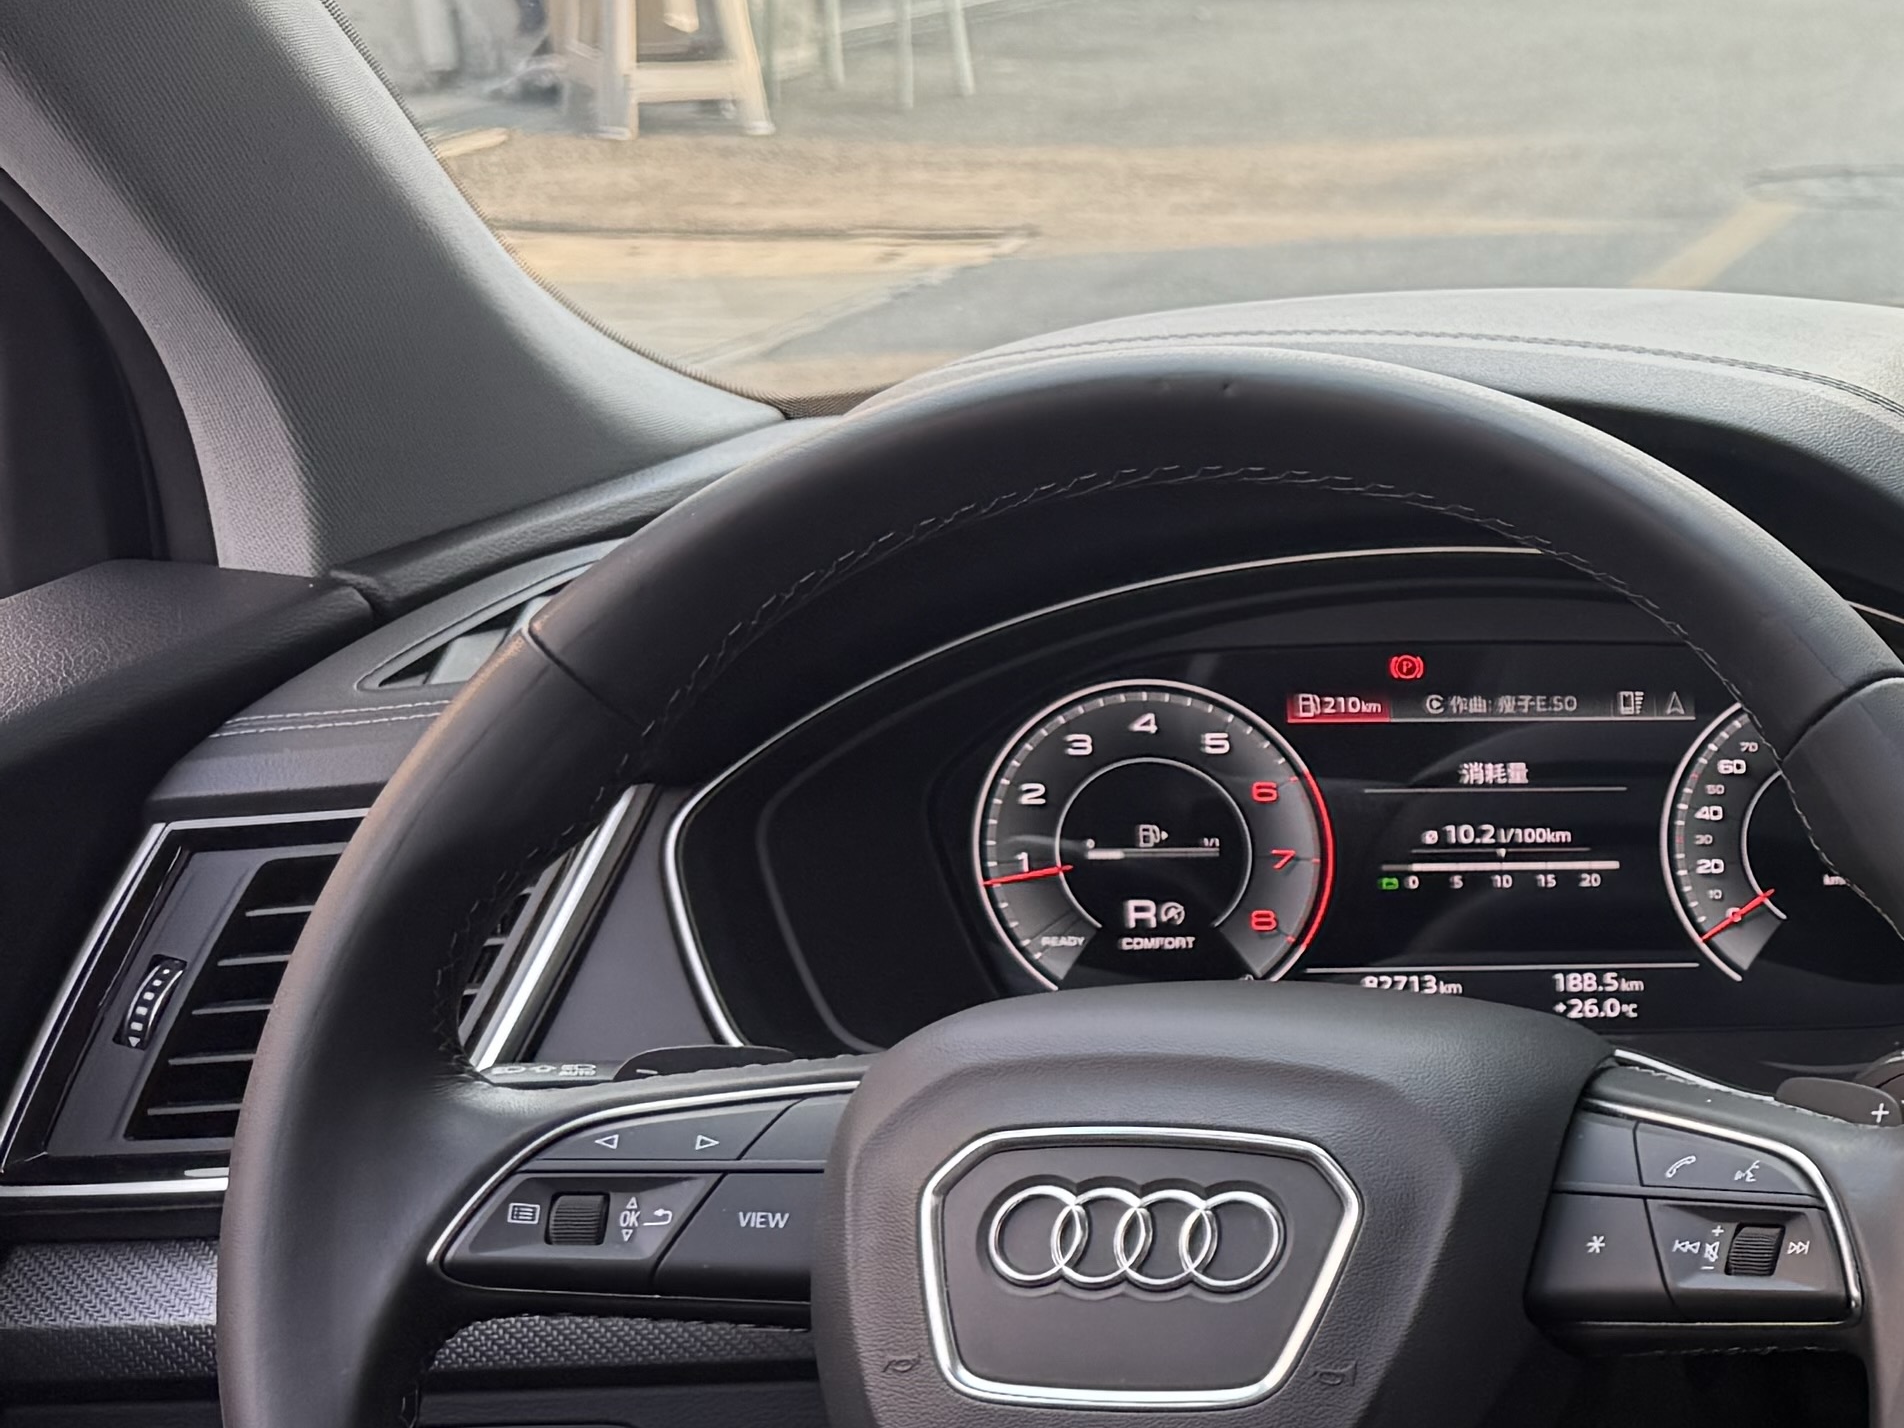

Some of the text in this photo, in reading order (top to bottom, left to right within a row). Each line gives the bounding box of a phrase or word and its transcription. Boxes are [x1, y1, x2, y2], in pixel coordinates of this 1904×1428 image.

[1130, 712, 1158, 735] 4
[1065, 733, 1093, 756] 3
[1202, 732, 1230, 754] 5
[1740, 741, 1759, 753] 70
[1459, 761, 1529, 785] 消耗量
[1717, 760, 1747, 775] 60
[1018, 782, 1046, 805] 2
[1251, 780, 1278, 802] 6
[1694, 805, 1723, 821] 40
[1694, 834, 1713, 845] 30
[1016, 852, 1030, 873] 1
[1271, 848, 1297, 869] 7
[1695, 858, 1724, 874] 20
[1406, 873, 1601, 890] 0 5 10 15 20
[1125, 899, 1157, 929] R
[1250, 909, 1277, 931] 8
[1041, 936, 1085, 948] READY
[1121, 936, 1196, 951] COMFORT
[619, 1209, 640, 1228] OK
[738, 1211, 790, 1229] VIEW
